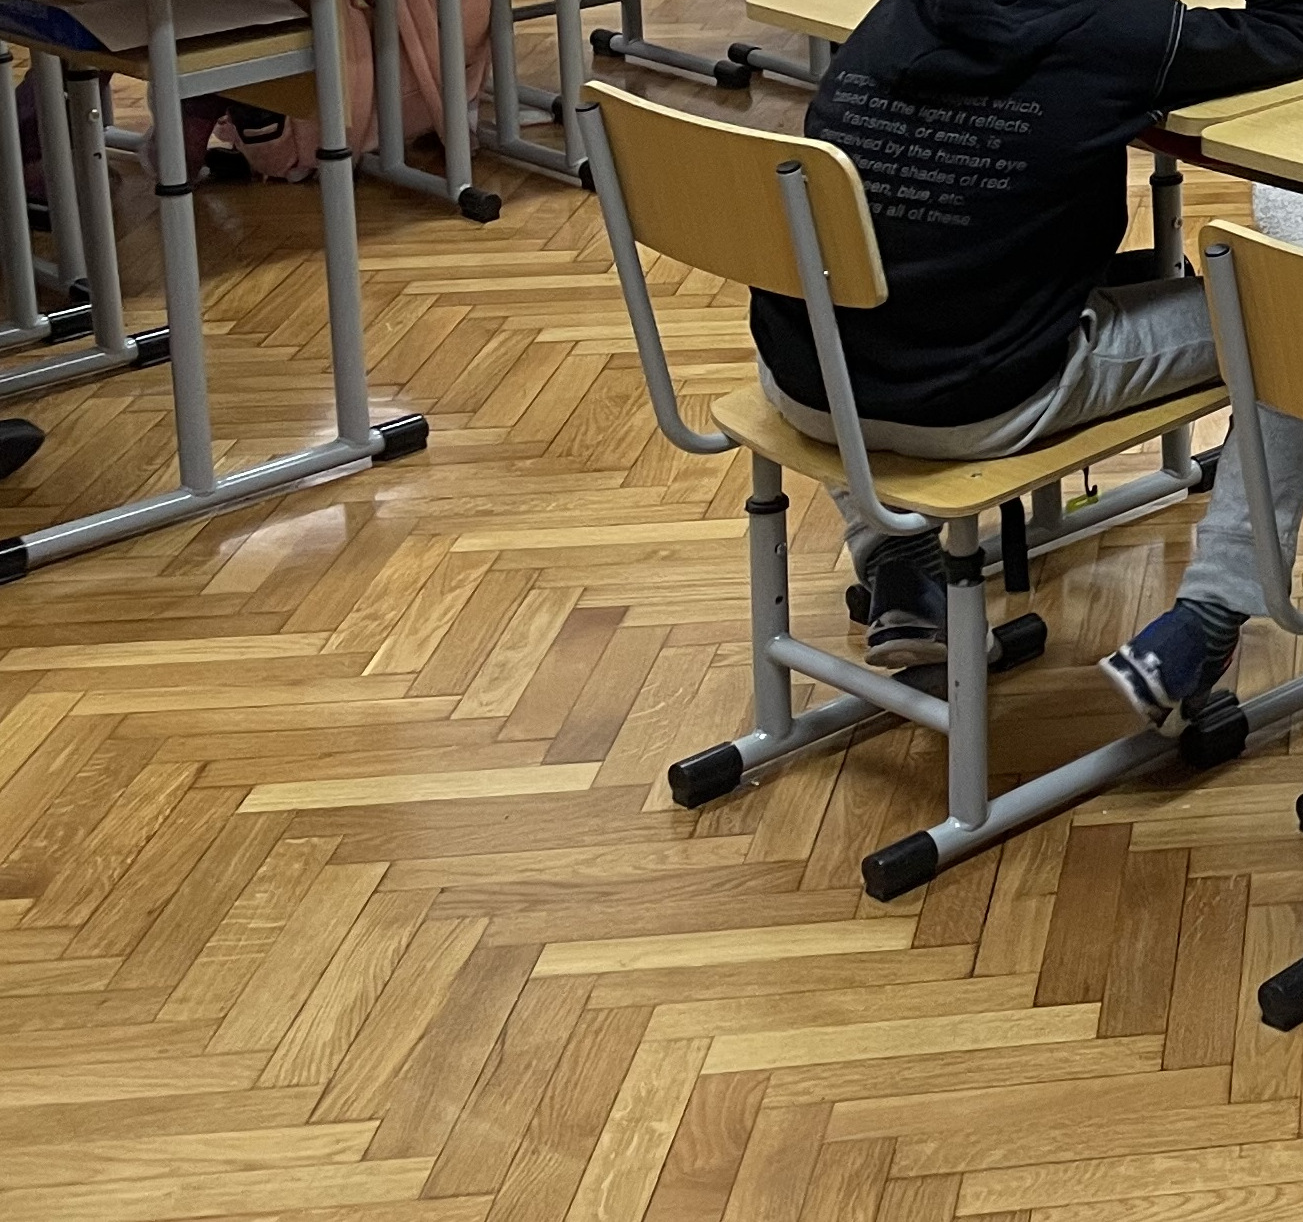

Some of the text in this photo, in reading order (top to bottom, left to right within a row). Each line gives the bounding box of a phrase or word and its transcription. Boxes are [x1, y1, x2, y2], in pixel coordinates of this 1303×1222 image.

[869, 97, 888, 110] on
[891, 101, 915, 115] the
[918, 106, 954, 124] light
[954, 110, 967, 124] it
[992, 97, 1044, 117] which,
[914, 126, 934, 138] or
[986, 135, 1002, 150] is
[885, 137, 905, 158] by
[907, 144, 932, 160] the
[935, 148, 991, 169] human
[995, 158, 1028, 173] eye
[901, 164, 954, 184] shades
[959, 172, 977, 186] of
[886, 204, 904, 218] all
[908, 207, 925, 221] of
[927, 210, 972, 227] these
